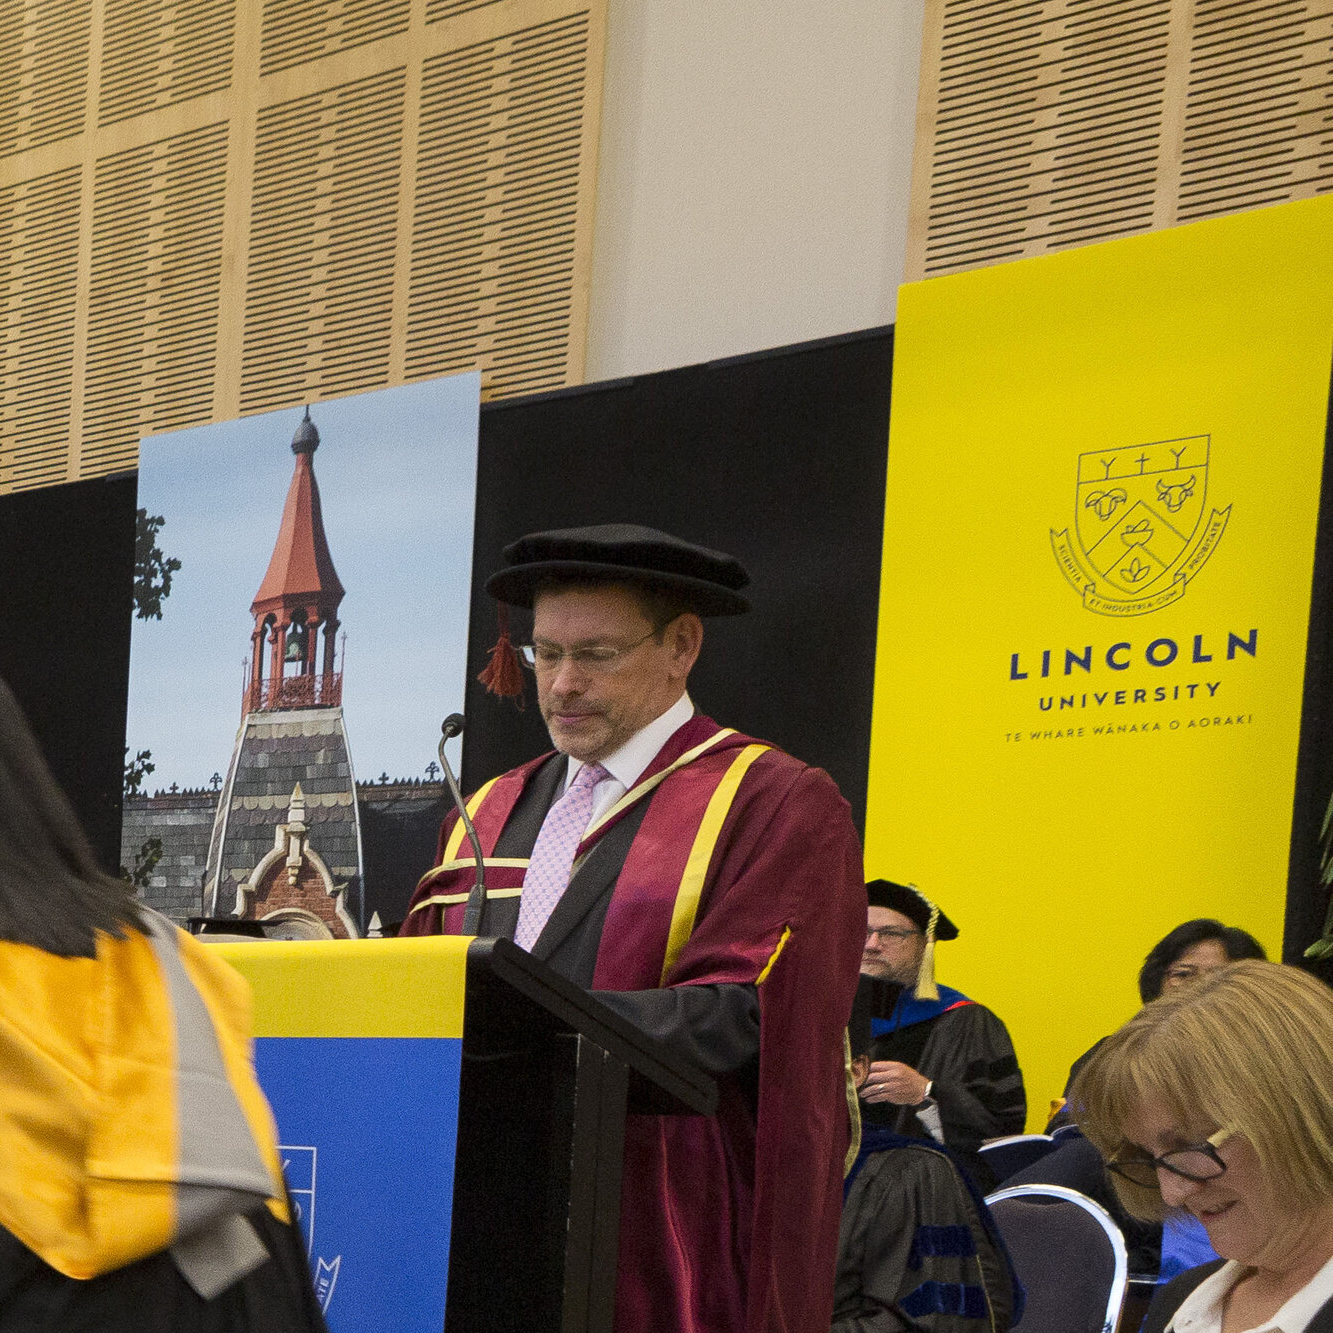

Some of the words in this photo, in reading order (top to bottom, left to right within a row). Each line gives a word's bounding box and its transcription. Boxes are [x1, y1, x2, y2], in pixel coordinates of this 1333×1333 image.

[1009, 629, 1258, 681] LINCOLN
[1039, 681, 1221, 711] UNIVERSITY
[1005, 733, 1022, 742] TE
[1030, 728, 1084, 740] WHARE
[1169, 720, 1180, 730] O
[1188, 714, 1253, 728] AORAKI
